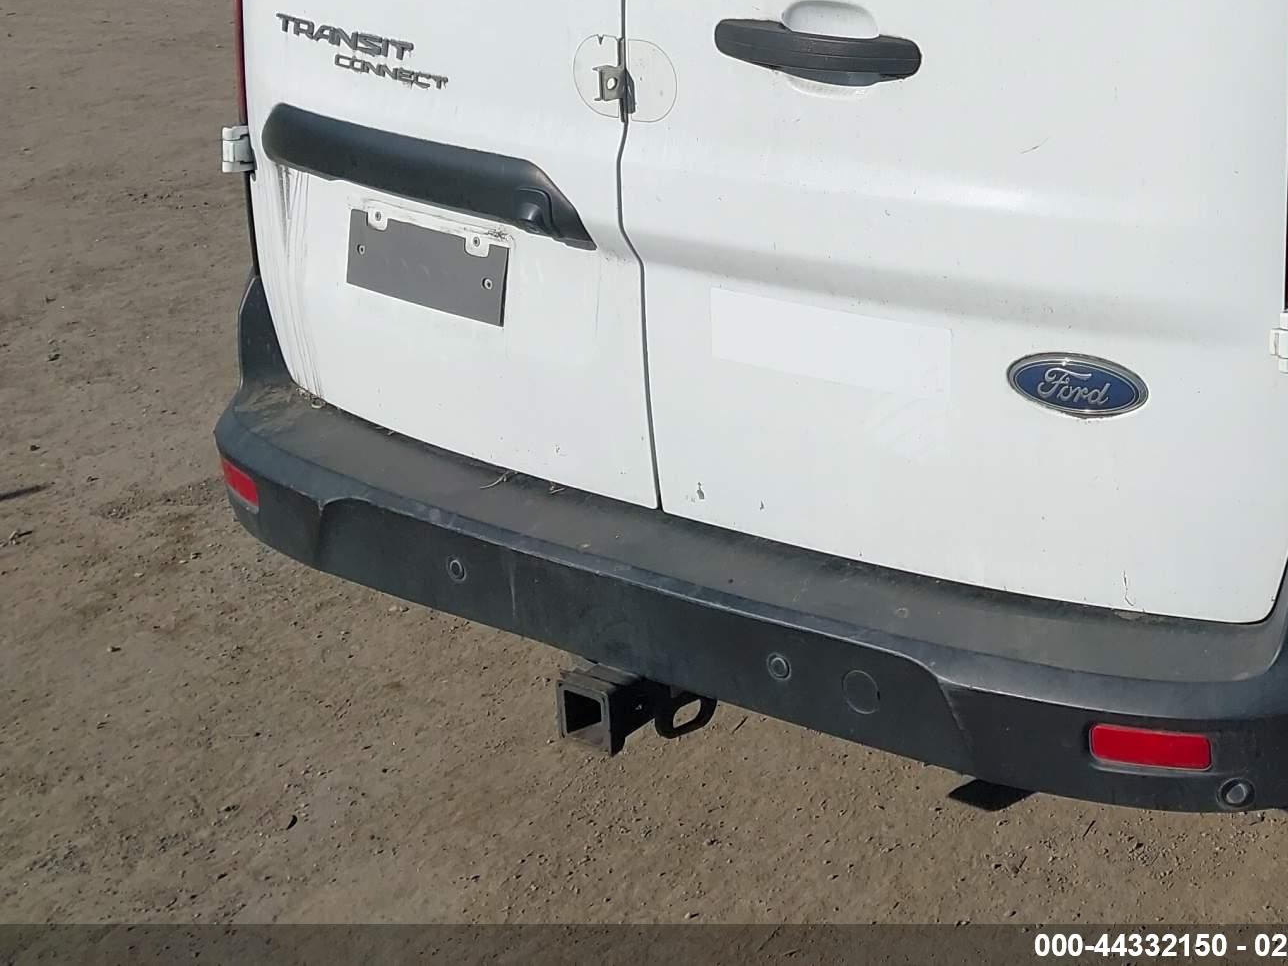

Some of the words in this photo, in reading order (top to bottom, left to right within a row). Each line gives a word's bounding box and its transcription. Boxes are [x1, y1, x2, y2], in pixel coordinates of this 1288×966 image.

[275, 12, 414, 61] TRANSIT
[334, 53, 449, 90] CONNECT
[1036, 367, 1111, 406] Ford
